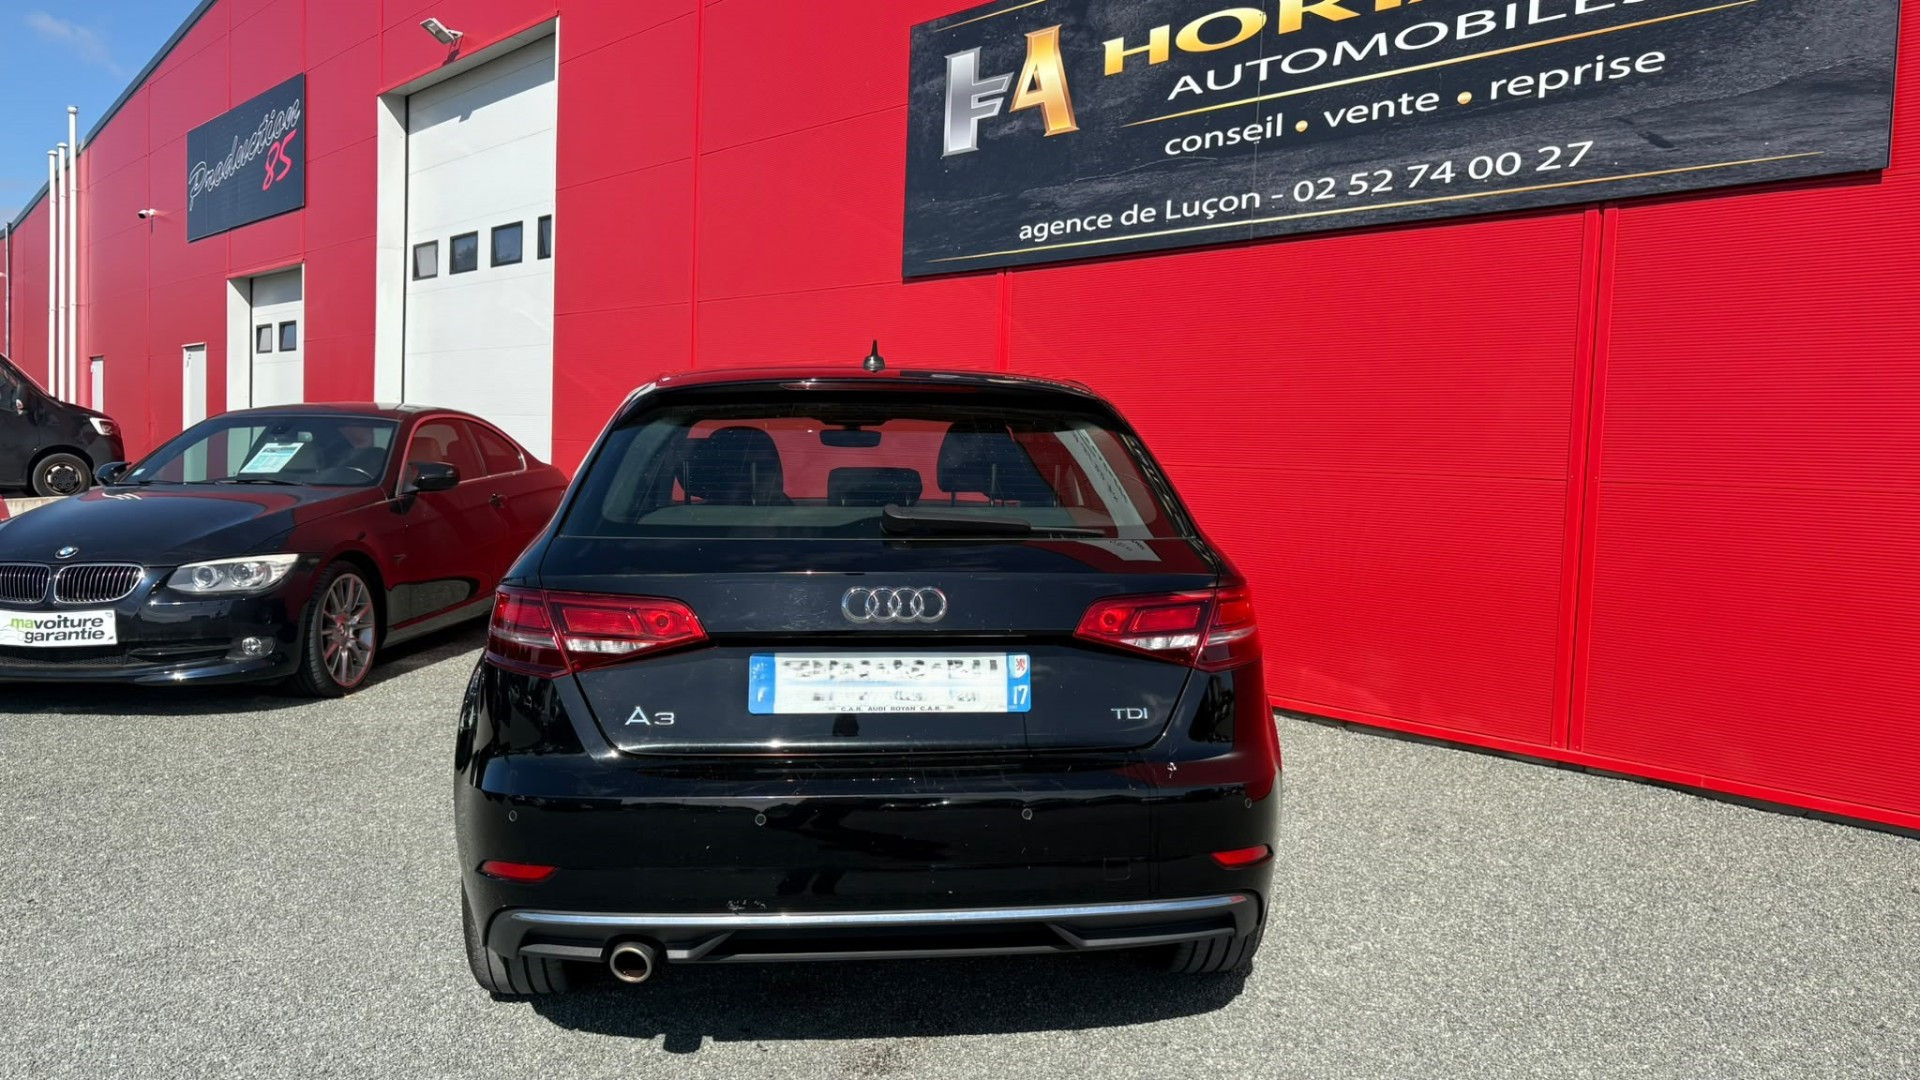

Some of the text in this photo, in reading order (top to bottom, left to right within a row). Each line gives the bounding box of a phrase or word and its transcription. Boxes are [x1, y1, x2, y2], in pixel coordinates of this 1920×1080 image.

[1102, 0, 1425, 76] HOR
[1167, 0, 1645, 100] AUTOMOBIL
[1164, 51, 1666, 155] conseil vente reprise
[188, 98, 300, 211] Production
[262, 129, 297, 191] 85
[1019, 212, 1113, 242] agence
[1120, 203, 1156, 226] de
[1166, 191, 1260, 219] Luçon
[1293, 177, 1336, 202] 02
[1347, 169, 1393, 195] 52
[1407, 160, 1455, 188] 74
[1468, 151, 1522, 180] 00
[1535, 140, 1594, 172] 27
[24, 628, 105, 644] garantie
[624, 705, 675, 726] A3
[1013, 684, 1028, 705] 17
[1110, 707, 1148, 720] TDI
